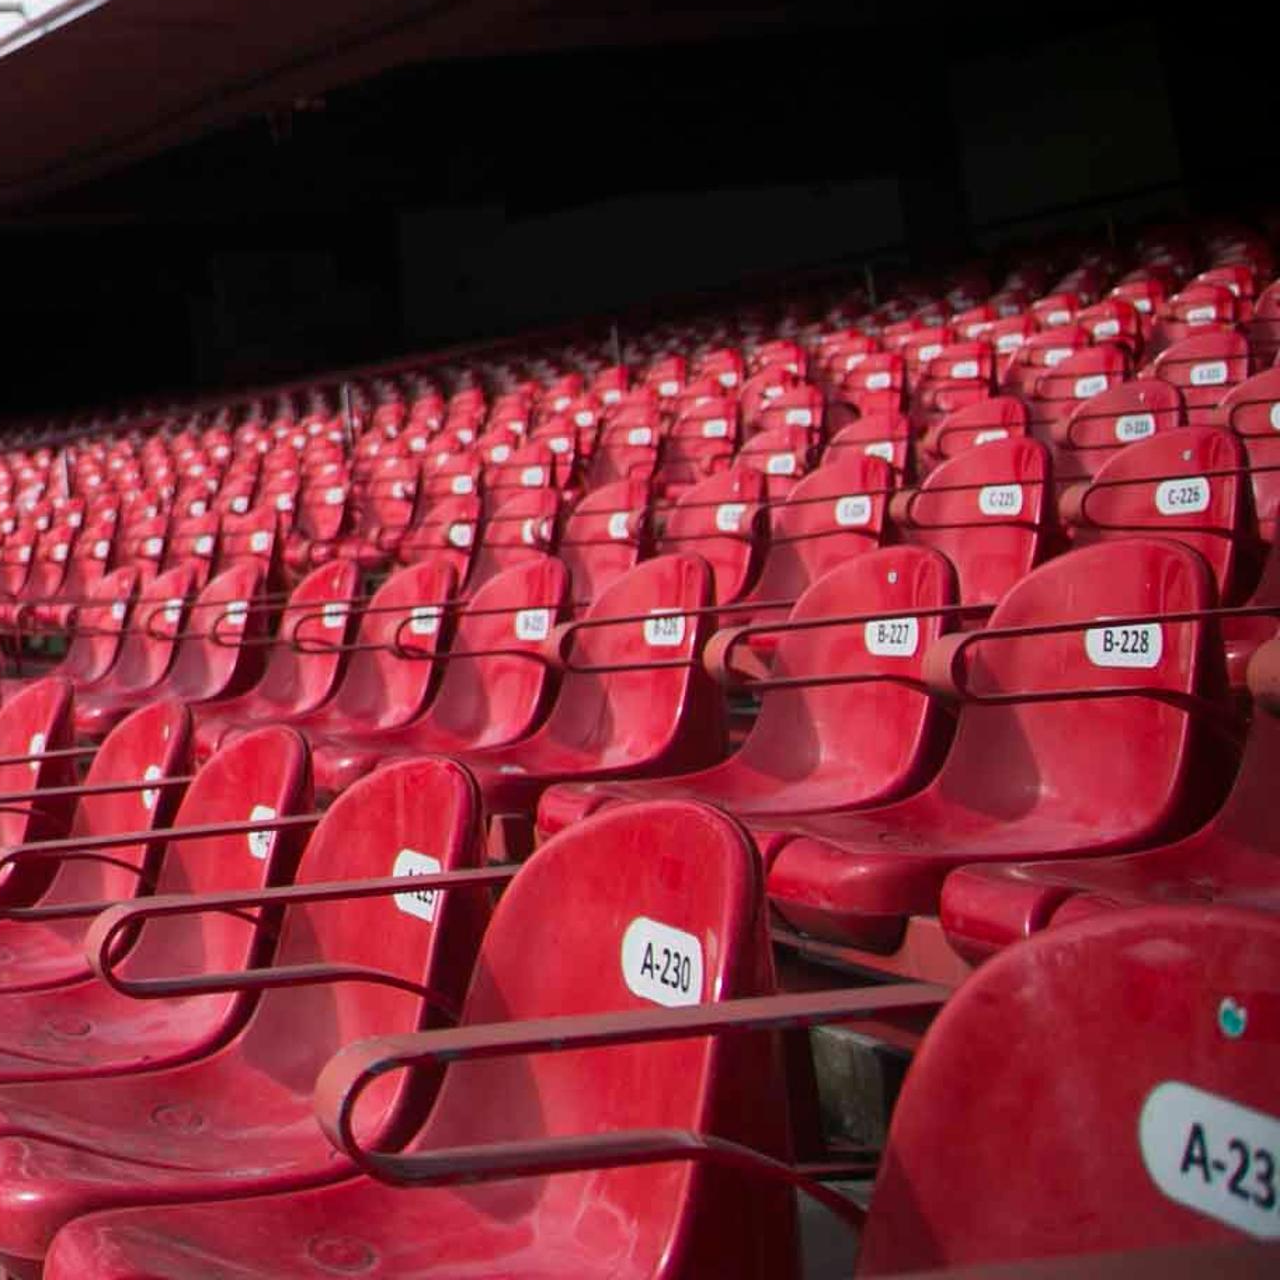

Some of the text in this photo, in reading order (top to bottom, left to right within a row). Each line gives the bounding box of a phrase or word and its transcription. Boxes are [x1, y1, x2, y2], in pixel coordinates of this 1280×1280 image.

[1167, 486, 1201, 506] C-226
[878, 623, 910, 644] B-227
[1103, 630, 1150, 654] B-228
[640, 942, 691, 993] A-230
[1180, 1122, 1277, 1211] A-23
